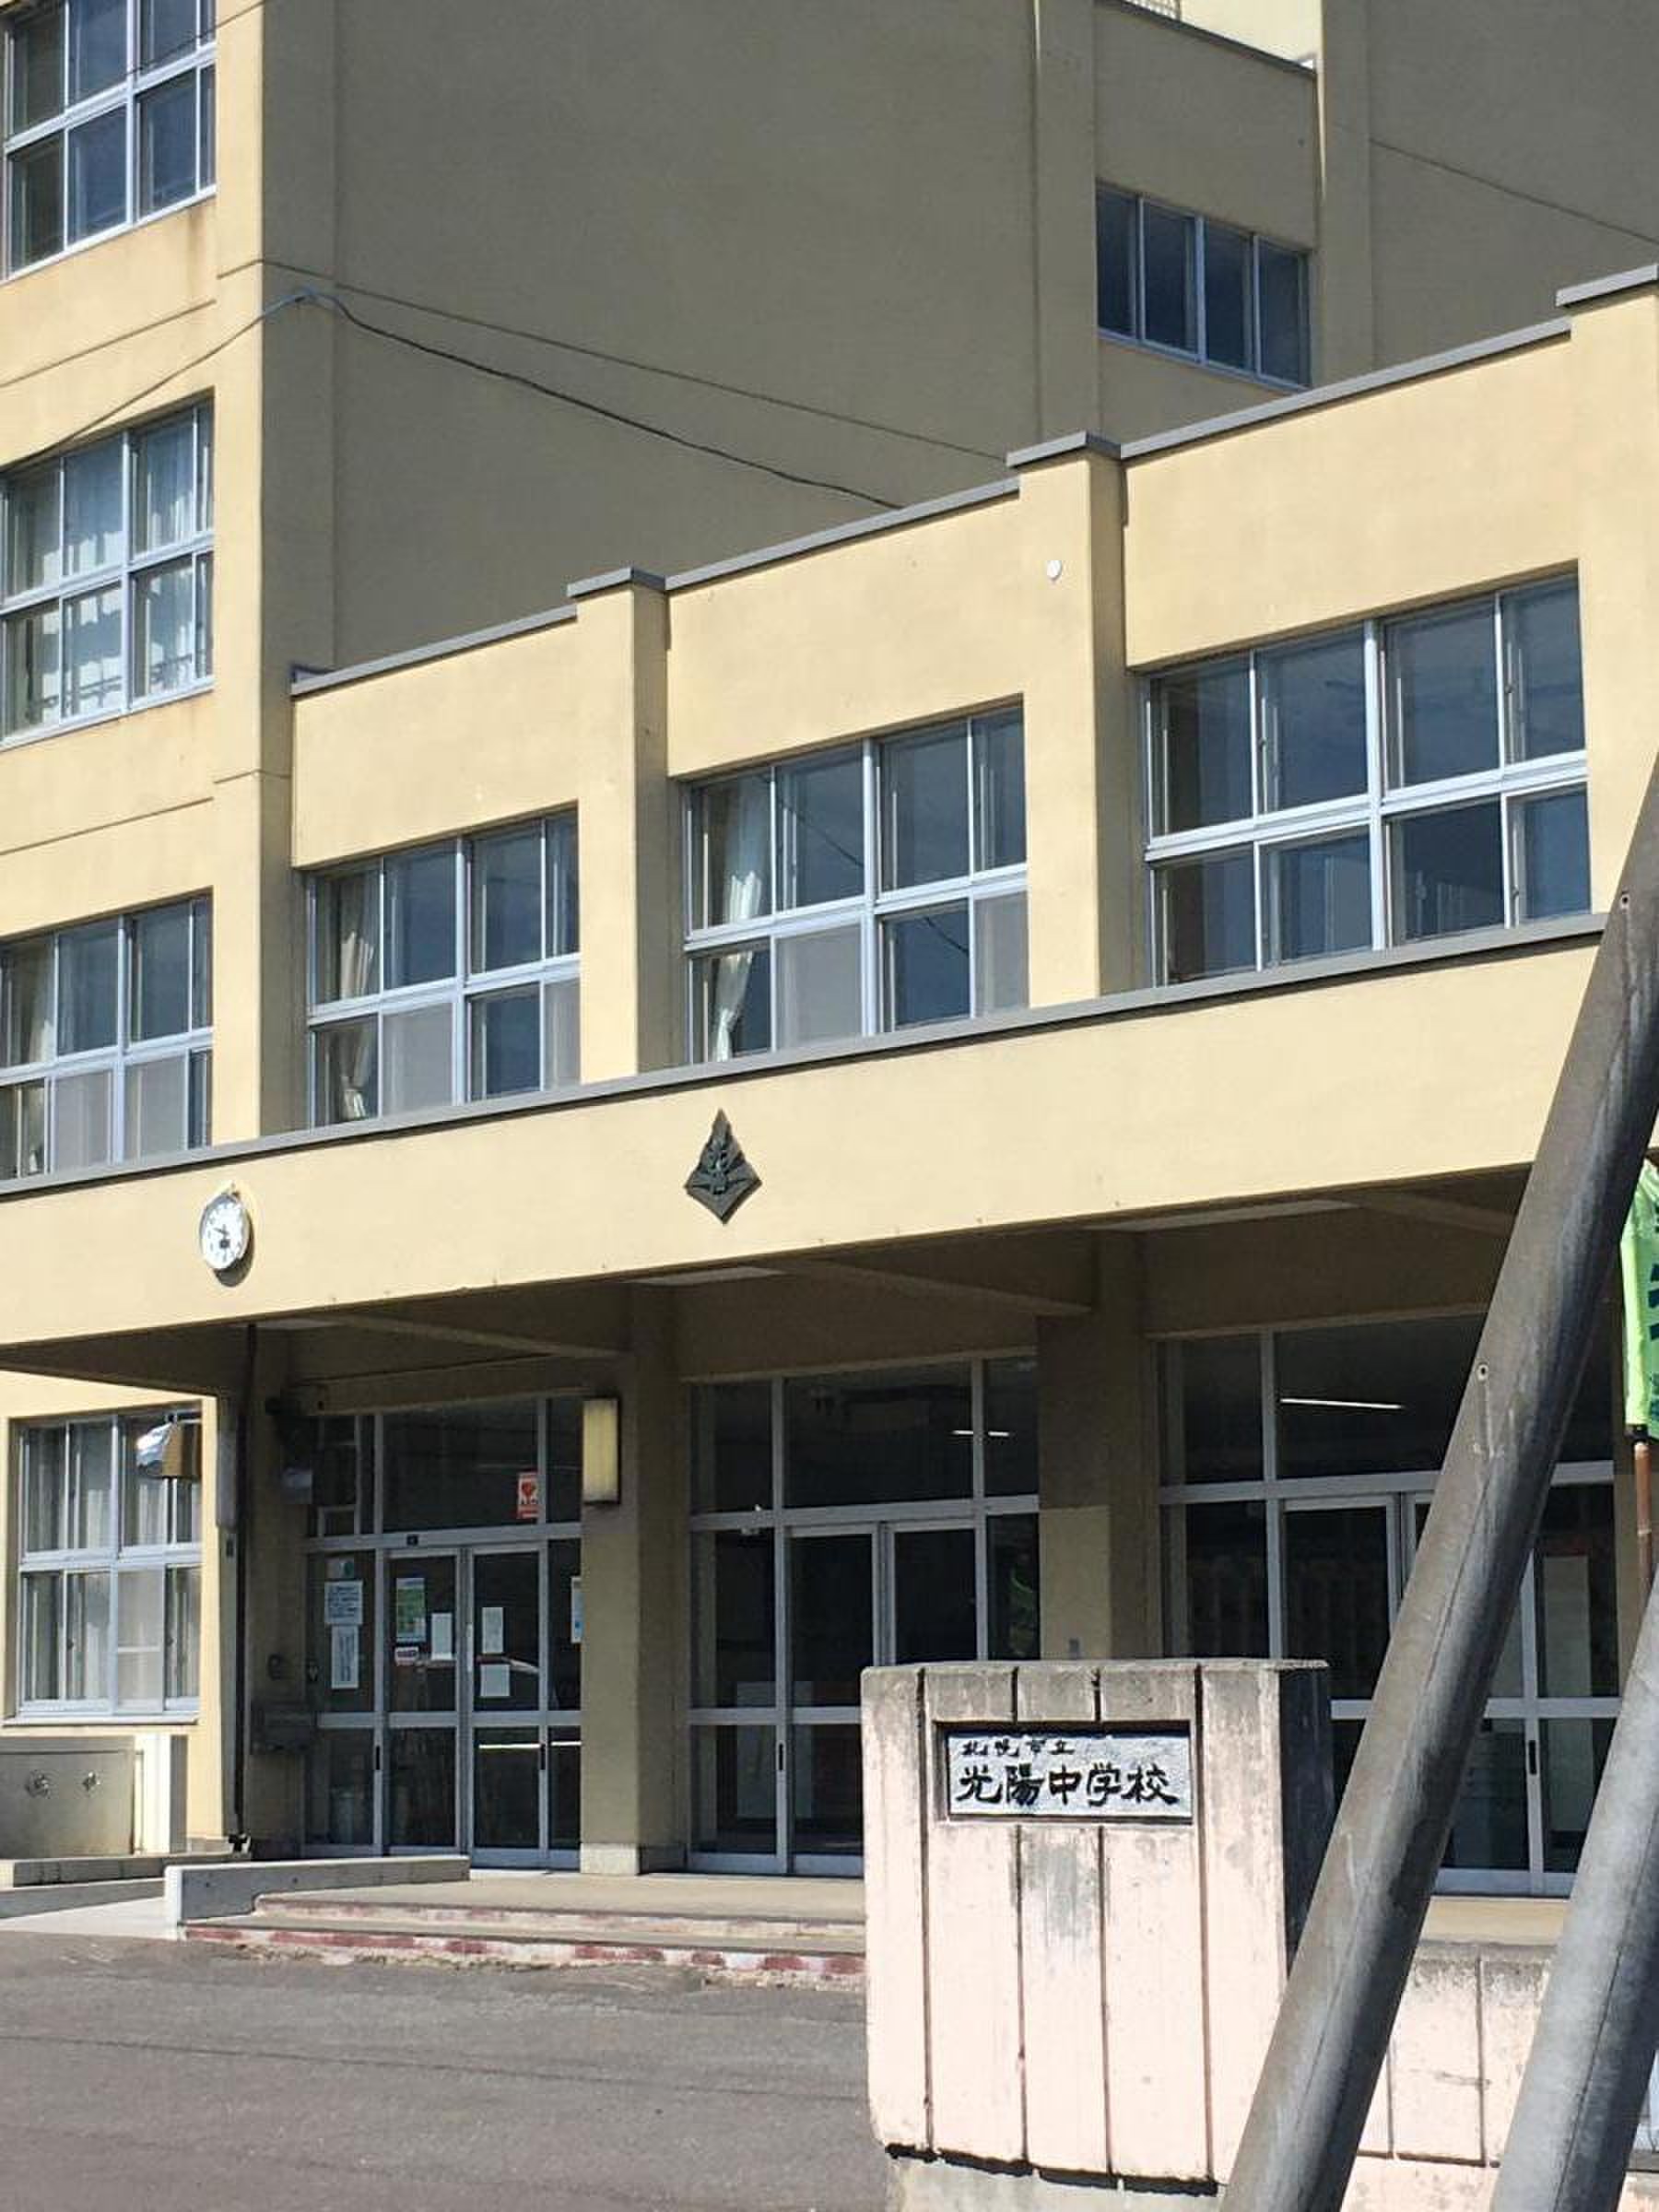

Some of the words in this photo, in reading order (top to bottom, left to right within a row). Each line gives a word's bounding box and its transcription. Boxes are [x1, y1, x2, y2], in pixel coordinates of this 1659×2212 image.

[956, 1761, 1180, 1806] 光陽中学校
